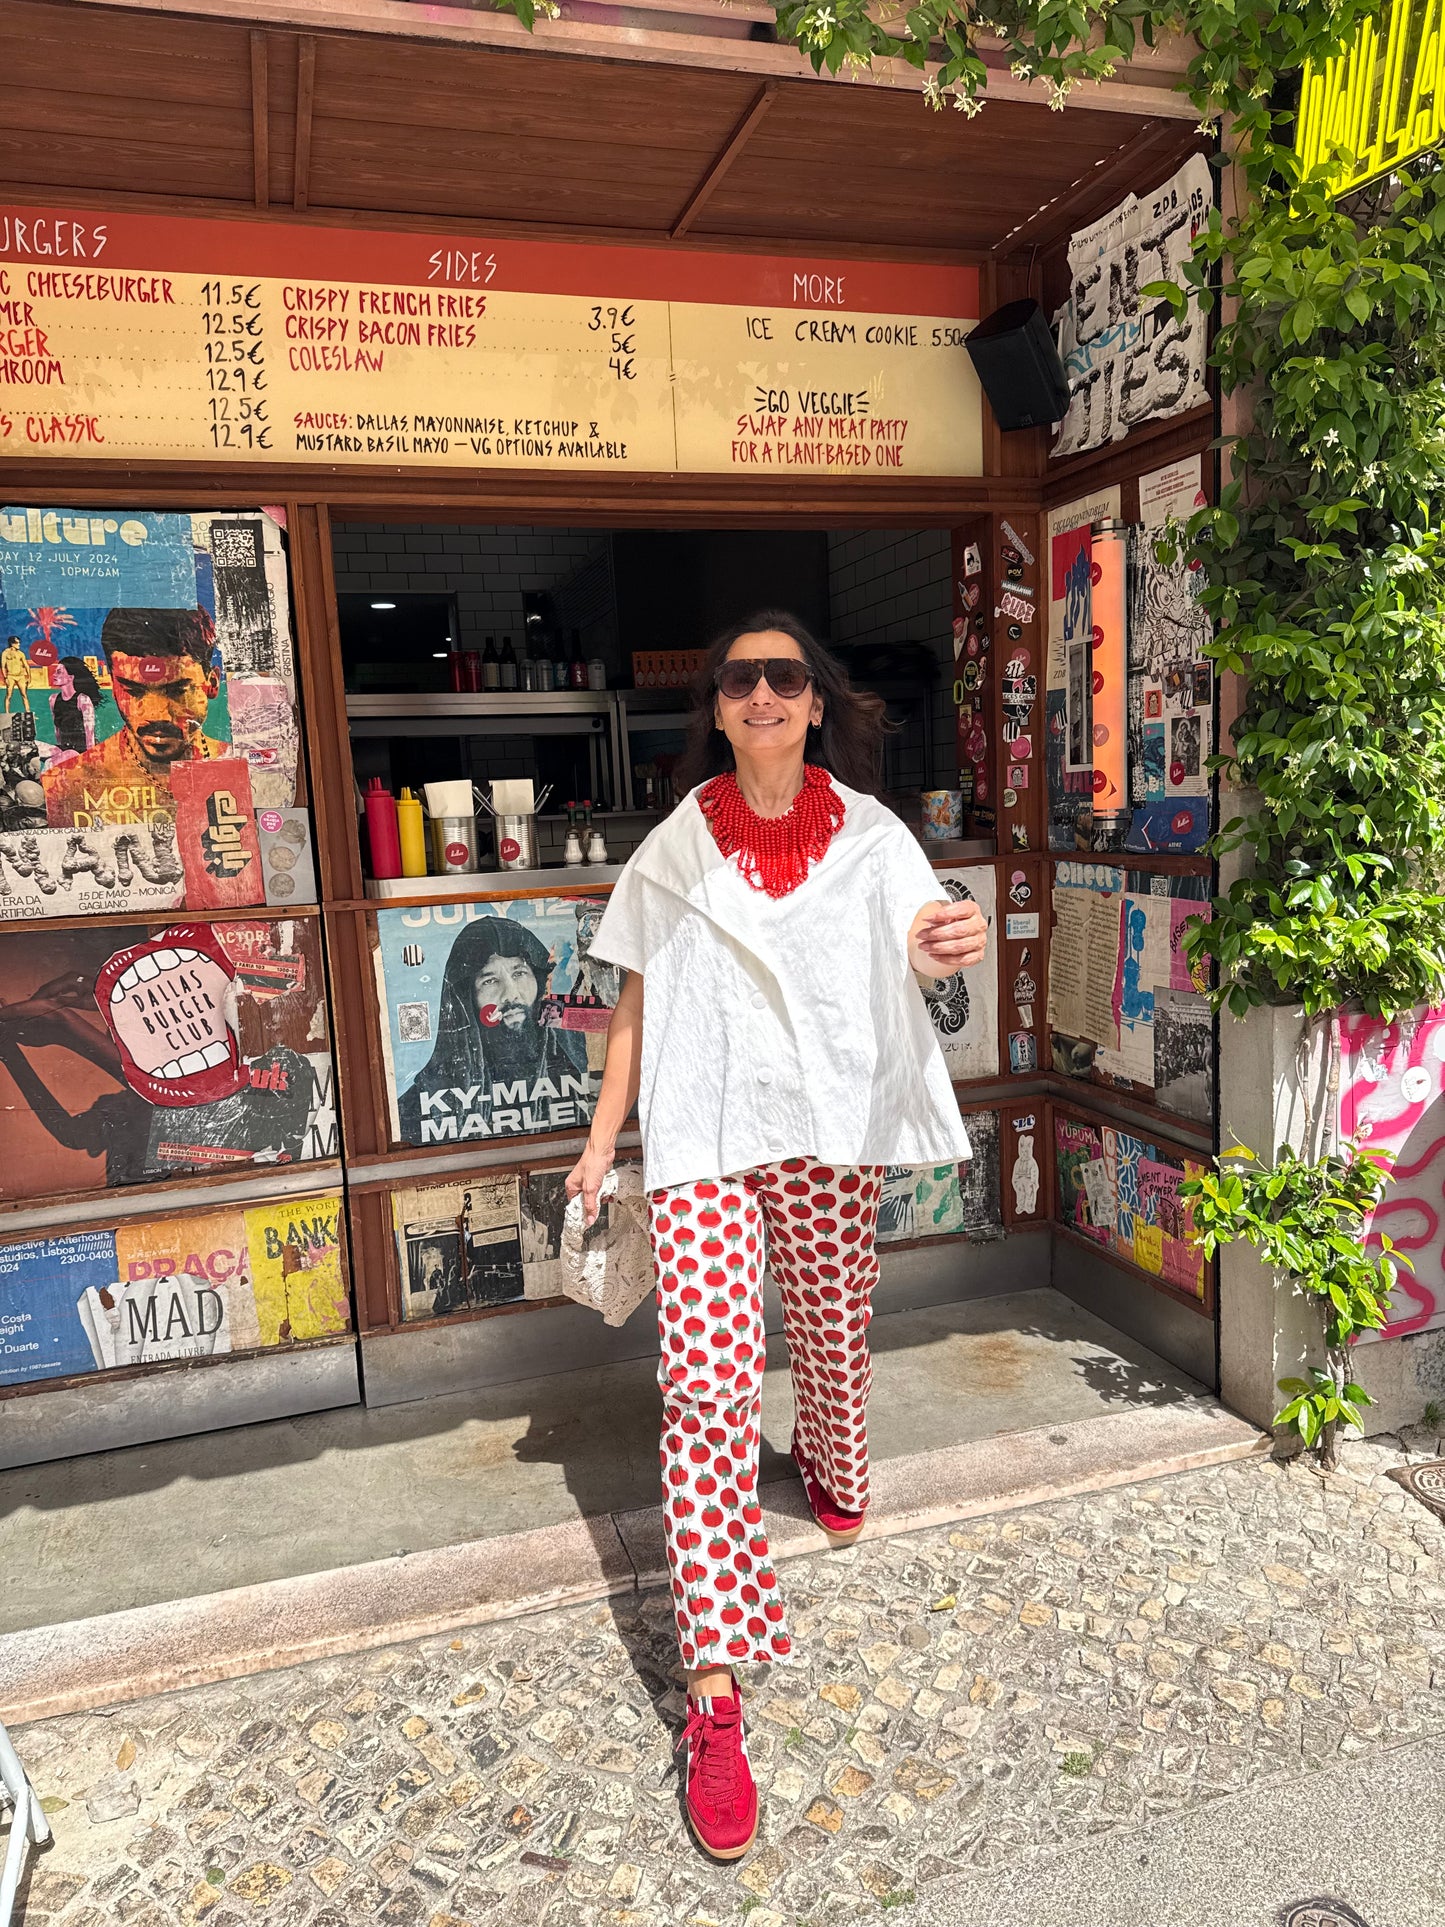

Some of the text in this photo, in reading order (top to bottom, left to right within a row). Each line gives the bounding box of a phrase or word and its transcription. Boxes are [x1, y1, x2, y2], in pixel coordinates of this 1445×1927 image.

[427, 248, 498, 284] SIDES
[27, 271, 174, 305] CHEESEBURGER
[201, 283, 262, 308] 11.5€
[792, 273, 847, 305] MORE
[282, 286, 636, 331] CRISPY FRENCH FRIES 3.9€
[202, 312, 264, 337] 12.5€
[285, 315, 637, 355] CRISPY BACON FRIES 5€
[746, 317, 774, 341] ICE
[794, 319, 857, 346] CREAM
[865, 326, 919, 347] COOKIE
[204, 341, 266, 366] 12.5€
[289, 345, 638, 381] COLESLAW 4€
[208, 368, 269, 393] 12.9€
[208, 397, 270, 423] 12.5€
[766, 389, 857, 416] GO VEGGIE
[27, 416, 106, 444] CLASSIC
[210, 425, 274, 451] 12.9€
[293, 412, 353, 430] SAUCES:
[414, 415, 509, 436] MAYONNAISE,
[514, 418, 579, 437] KETCHUP
[588, 421, 600, 439] &
[737, 414, 908, 441] SWAP ANY MEAT PATTY
[367, 436, 410, 453] BASIL
[413, 437, 449, 454] MAYO
[470, 437, 492, 455] VG
[496, 438, 553, 457] OPTIONS
[557, 441, 628, 459] AVAILABLE
[731, 440, 904, 468] FOR A PLANT-BASED ONE
[29, 552, 42, 562] 12
[49, 553, 80, 563] JULY
[89, 554, 118, 563] 2024
[61, 567, 120, 577] 10PM/6AM
[84, 786, 161, 810] MOTEL
[3, 895, 41, 906] ERA DA
[79, 891, 90, 900] 15
[92, 890, 104, 899] DE
[106, 888, 131, 898] MAIO
[79, 900, 128, 910] GAGLIANO
[401, 902, 516, 927] JULY
[131, 969, 204, 1013] DALLAS
[143, 993, 216, 1035] BURGER
[166, 1021, 214, 1051] CLUB
[419, 1072, 589, 1115] KY-MAN
[420, 1099, 592, 1143] MARLEY
[416, 1180, 472, 1192] RITMO LOCO
[279, 1207, 302, 1219] THE
[0, 1239, 45, 1253] Collective
[58, 1232, 113, 1245] Afterhours.
[0, 1246, 75, 1263] studios, Lisboa
[60, 1249, 114, 1264] 2300-0400
[0, 1323, 25, 1335] eight
[1, 1313, 32, 1324] Costa
[125, 1289, 224, 1346] MAD
[4, 1342, 40, 1354] Duarte
[130, 1346, 205, 1364] ENTRADA LIVRE
